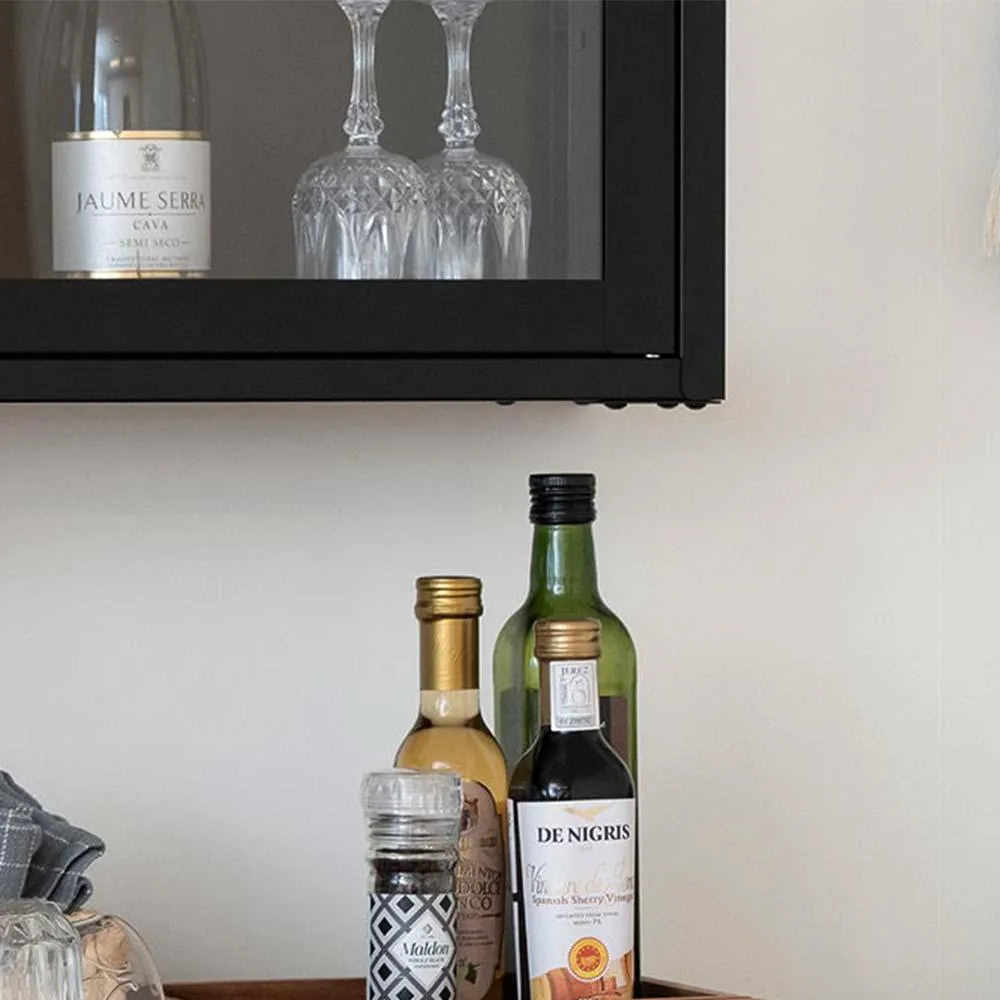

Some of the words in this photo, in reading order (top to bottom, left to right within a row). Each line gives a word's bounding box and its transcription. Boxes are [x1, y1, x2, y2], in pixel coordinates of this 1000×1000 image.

[76, 191, 151, 213] JAUME
[156, 190, 207, 210] SERRA
[132, 219, 169, 230] CAVA
[537, 827, 564, 843] DE
[567, 823, 631, 842] NIGRIS
[401, 941, 450, 957] Maldon
